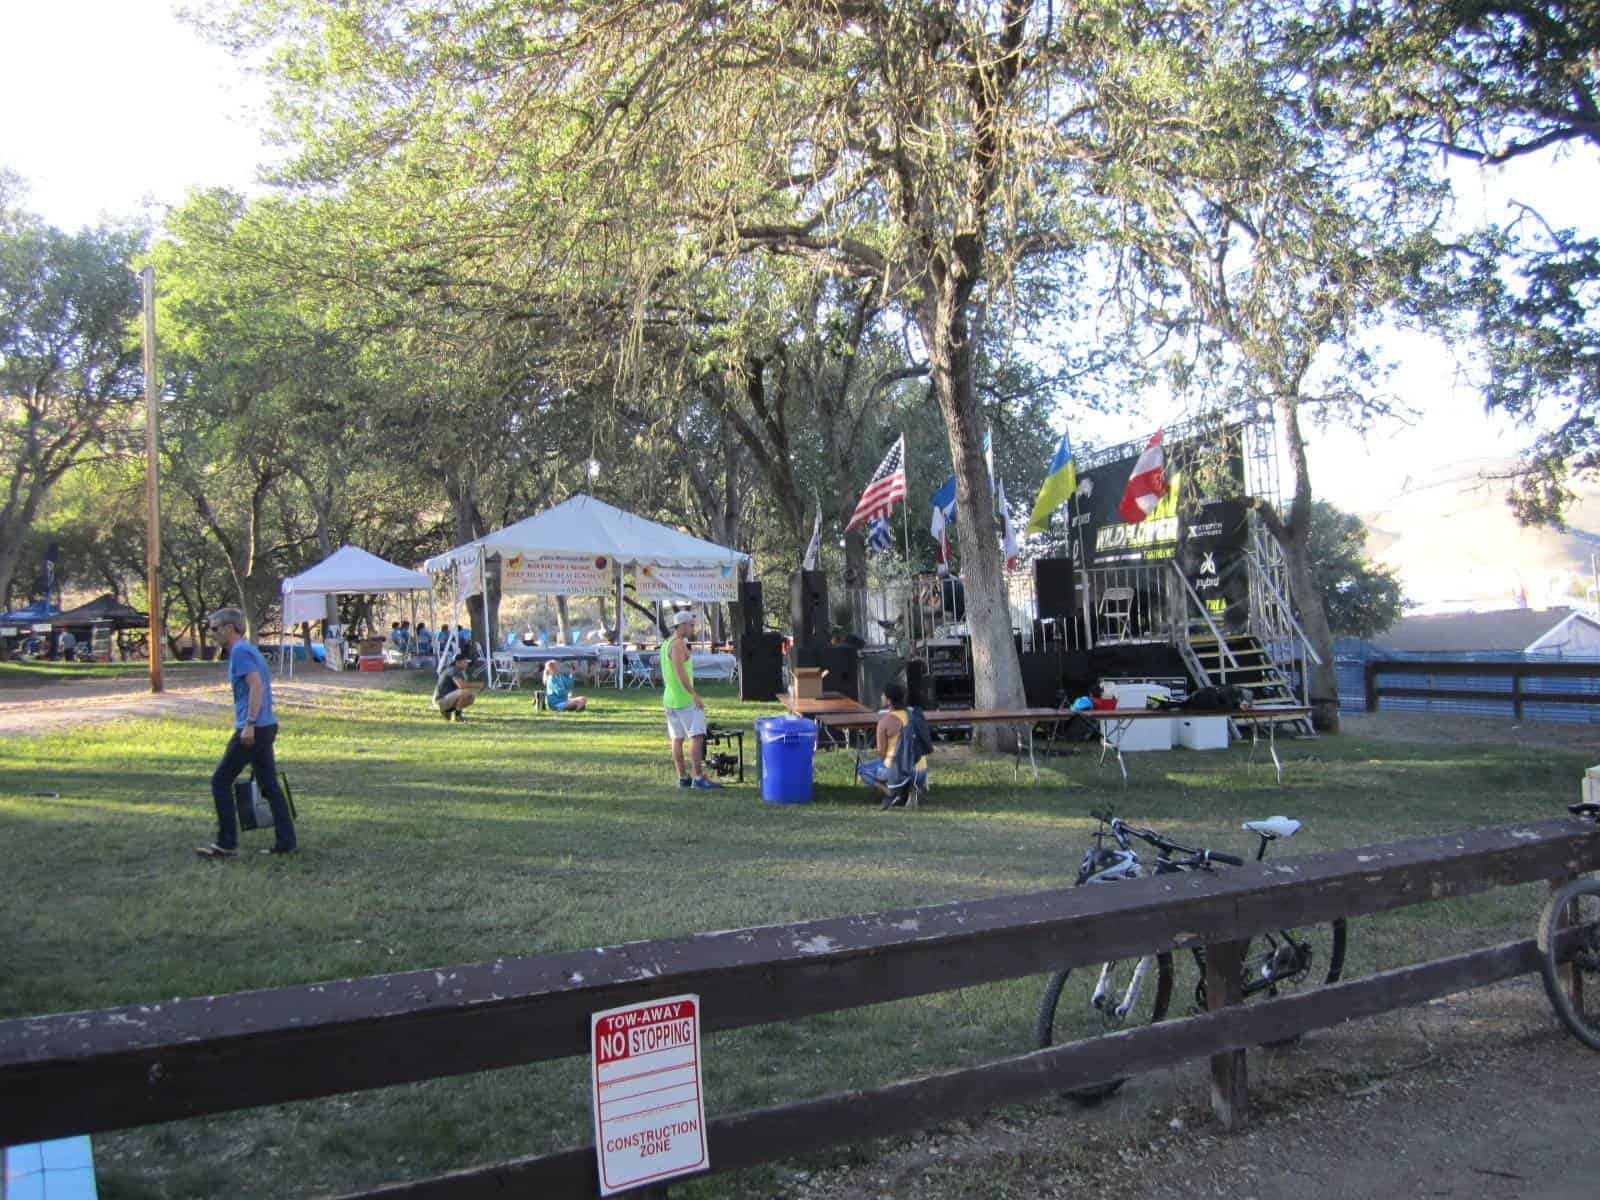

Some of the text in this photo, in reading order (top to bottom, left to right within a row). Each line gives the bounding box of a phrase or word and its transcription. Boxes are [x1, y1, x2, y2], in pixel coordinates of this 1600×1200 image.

[1096, 516, 1178, 552] WILDFLOWER
[607, 1005, 681, 1031] TOW-AWAY
[600, 1021, 690, 1060] NO STOPPING
[607, 1120, 697, 1153] CONSTRUCTION
[640, 1138, 671, 1158] ZONE
